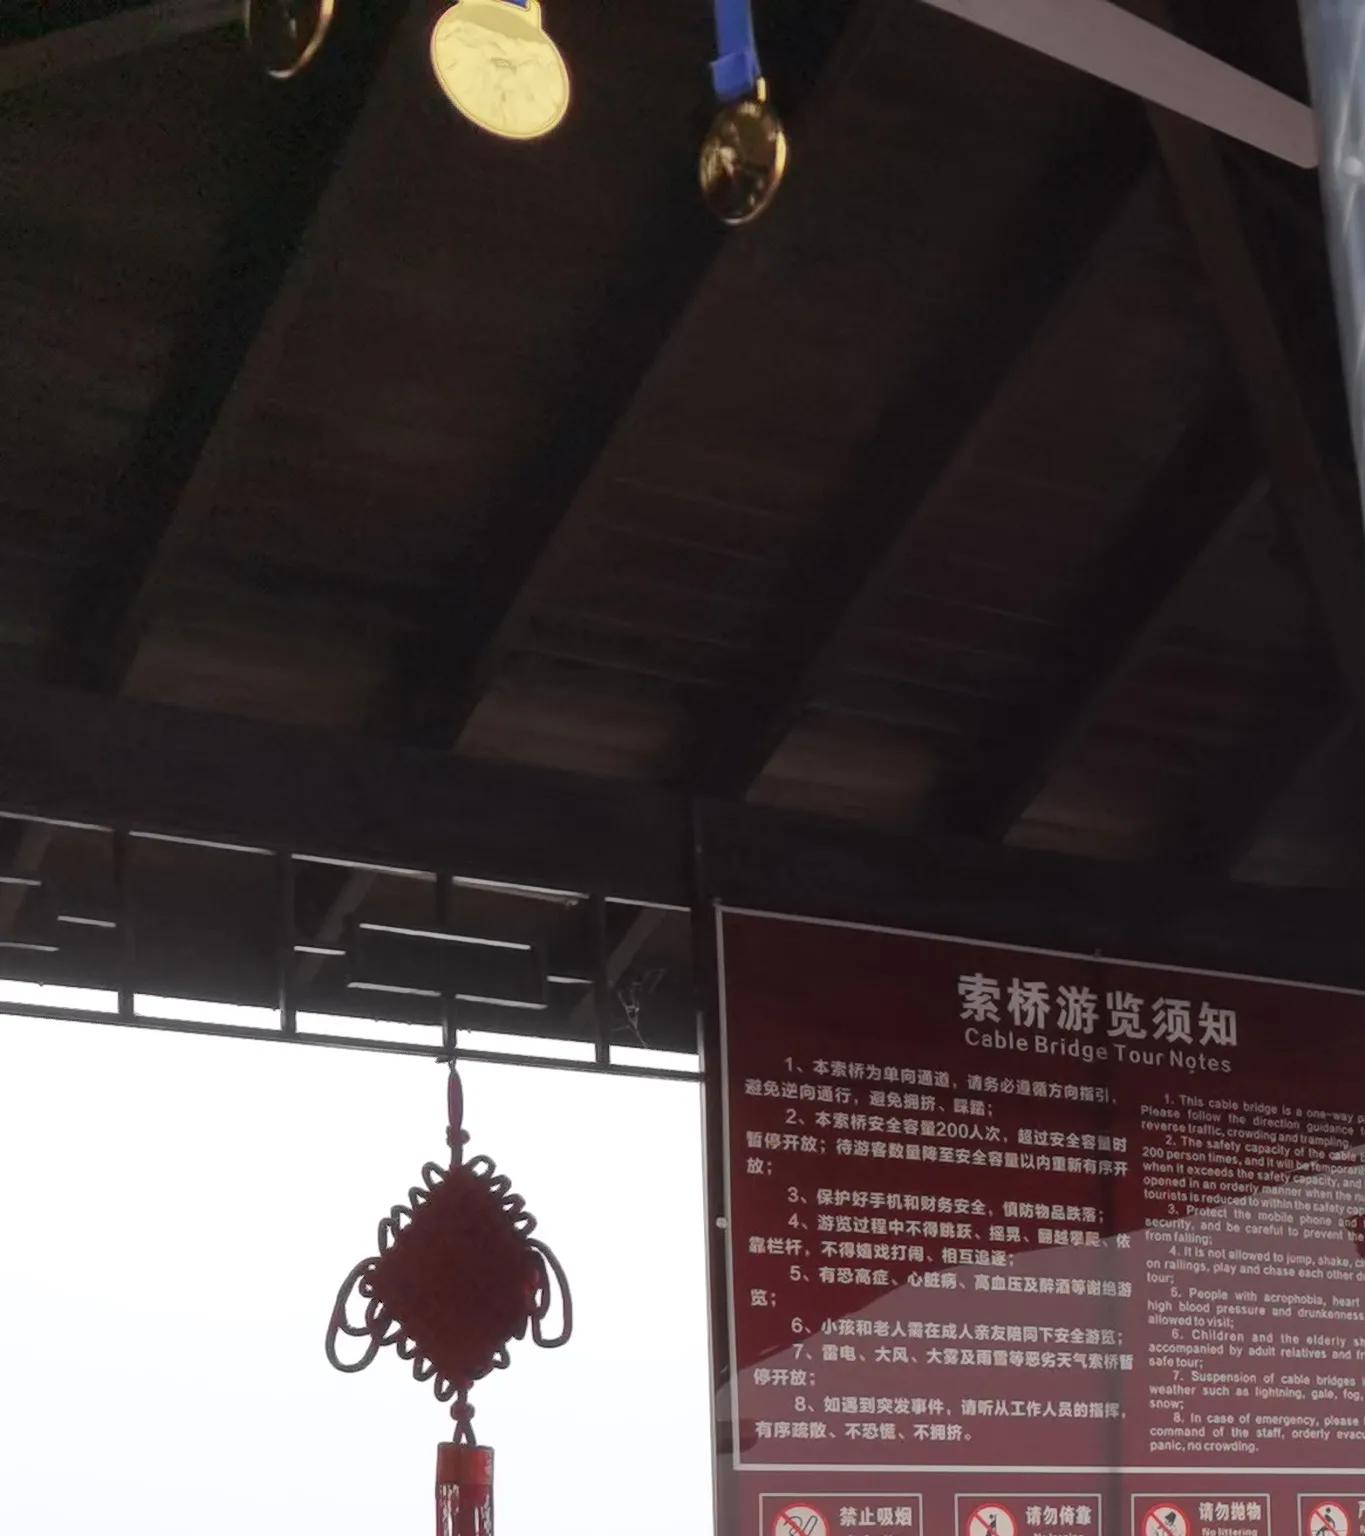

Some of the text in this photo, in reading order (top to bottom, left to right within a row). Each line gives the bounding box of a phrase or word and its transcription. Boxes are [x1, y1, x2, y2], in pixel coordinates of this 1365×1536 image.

[957, 972, 1238, 1048] 索桥游览须知
[965, 1027, 1232, 1073] Cable Bridge Tour Notes
[746, 1157, 773, 1175] 放；
[1145, 1230, 1171, 1242] from
[1183, 1247, 1192, 1257] It
[1194, 1247, 1204, 1258] is
[1207, 1248, 1226, 1259] not
[1228, 1249, 1270, 1262] allowed
[1272, 1252, 1283, 1263] to
[1145, 1260, 1161, 1270] on
[1212, 1262, 1237, 1276] play
[1239, 1264, 1260, 1275] and
[1262, 1265, 1295, 1277] chase
[1297, 1267, 1324, 1278] each
[1325, 1268, 1354, 1280] other
[750, 1289, 776, 1307] 览；
[1188, 1288, 1228, 1303] People
[1234, 1290, 1257, 1302] with
[1331, 1295, 1360, 1306] heart
[1146, 1300, 1172, 1314] high
[1178, 1302, 1210, 1314] blood
[1215, 1305, 1266, 1318] pressure
[1271, 1306, 1292, 1317] and
[1148, 1313, 1192, 1325] allowed
[1193, 1315, 1205, 1326] to
[1191, 1330, 1244, 1342] Children
[1251, 1332, 1273, 1343] and
[1280, 1333, 1299, 1344] the
[1305, 1334, 1346, 1348] elderly
[1148, 1342, 1226, 1357] accompanied
[1228, 1345, 1243, 1358] by
[1248, 1346, 1275, 1357] adult
[1279, 1347, 1327, 1359] relatives
[1331, 1349, 1352, 1360] and
[1148, 1355, 1173, 1366] safe
[753, 1369, 816, 1387] 停开放；
[1191, 1371, 1256, 1386] Suspension
[1263, 1373, 1274, 1384] of
[1280, 1374, 1310, 1385] cable
[1315, 1375, 1355, 1388] bridges
[1149, 1384, 1195, 1396] weather
[1202, 1386, 1229, 1396] such
[1235, 1388, 1249, 1397] as
[1190, 1413, 1201, 1423] In
[1206, 1415, 1234, 1424] case
[1239, 1414, 1250, 1424] of
[1324, 1415, 1359, 1428] please
[1150, 1426, 1205, 1437] command
[1212, 1427, 1224, 1437] of
[1231, 1427, 1249, 1438] the
[1291, 1428, 1329, 1441] orderly
[1186, 1442, 1202, 1451] no
[839, 1506, 912, 1527] 禁止吸烟
[1025, 1505, 1092, 1526] 请勿倚靠
[1199, 1502, 1261, 1521] 请勿抛物
[1202, 1528, 1216, 1536] No
